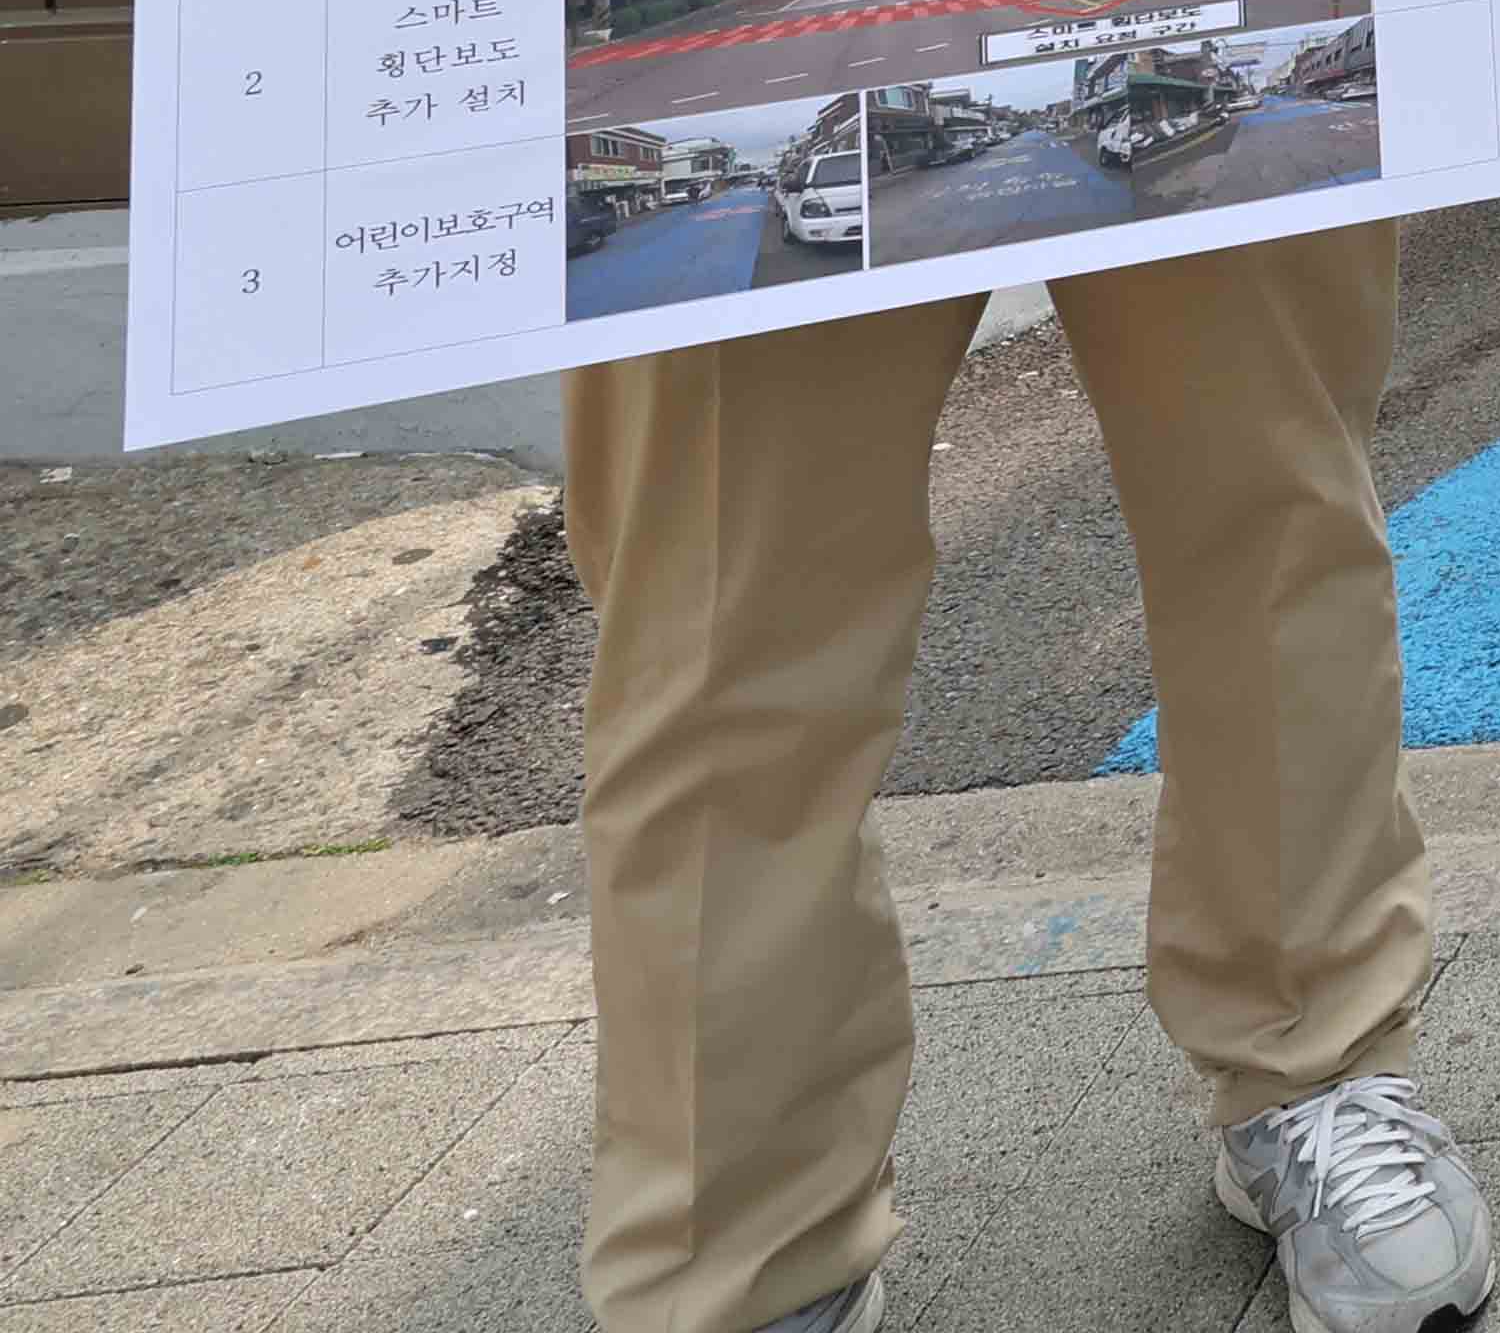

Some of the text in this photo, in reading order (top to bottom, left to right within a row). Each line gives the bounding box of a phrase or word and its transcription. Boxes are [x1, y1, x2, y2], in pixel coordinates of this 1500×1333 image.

[376, 37, 521, 79] 횡단보도
[244, 70, 263, 96] 2
[365, 80, 527, 126] 추가 설치
[335, 196, 555, 254] 어린이보호구역
[241, 269, 261, 294] 3
[372, 248, 518, 297] 추가지정
